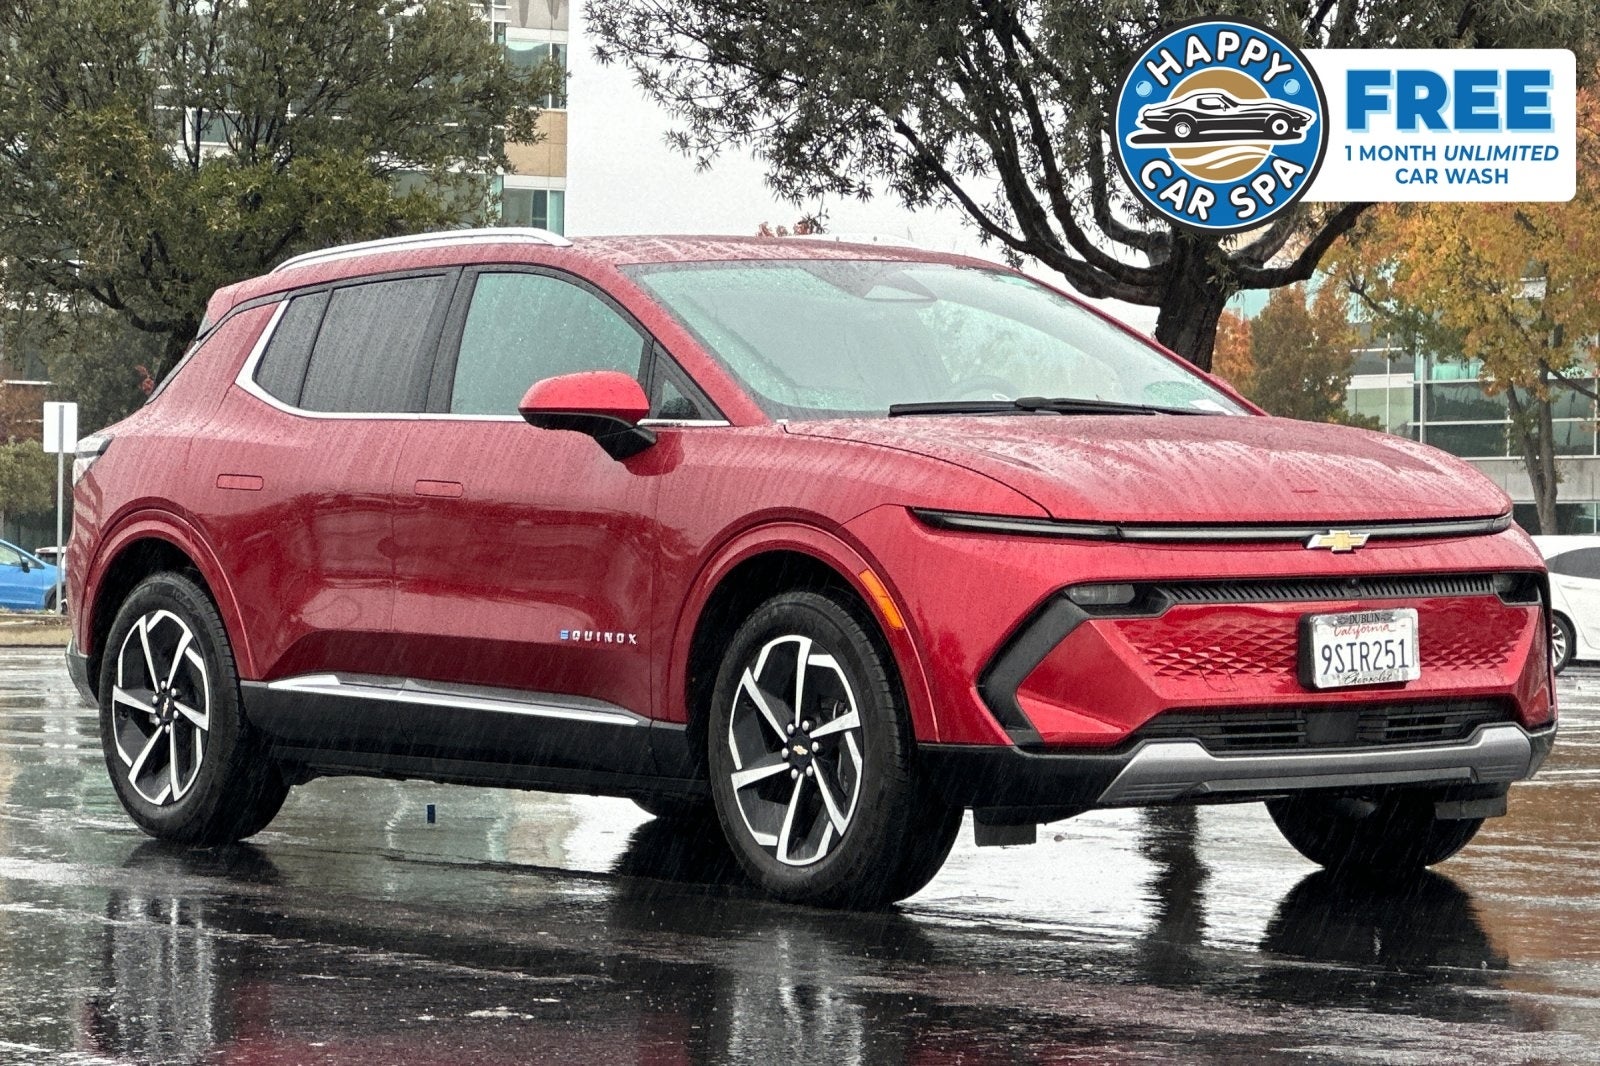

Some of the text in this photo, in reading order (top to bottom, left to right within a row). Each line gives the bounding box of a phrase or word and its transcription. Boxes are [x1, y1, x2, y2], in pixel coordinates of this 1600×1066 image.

[1348, 613, 1381, 624] DUBLIN
[560, 629, 637, 645] EQUINOX
[1333, 623, 1396, 640] California
[1321, 638, 1410, 676] 9SIR251
